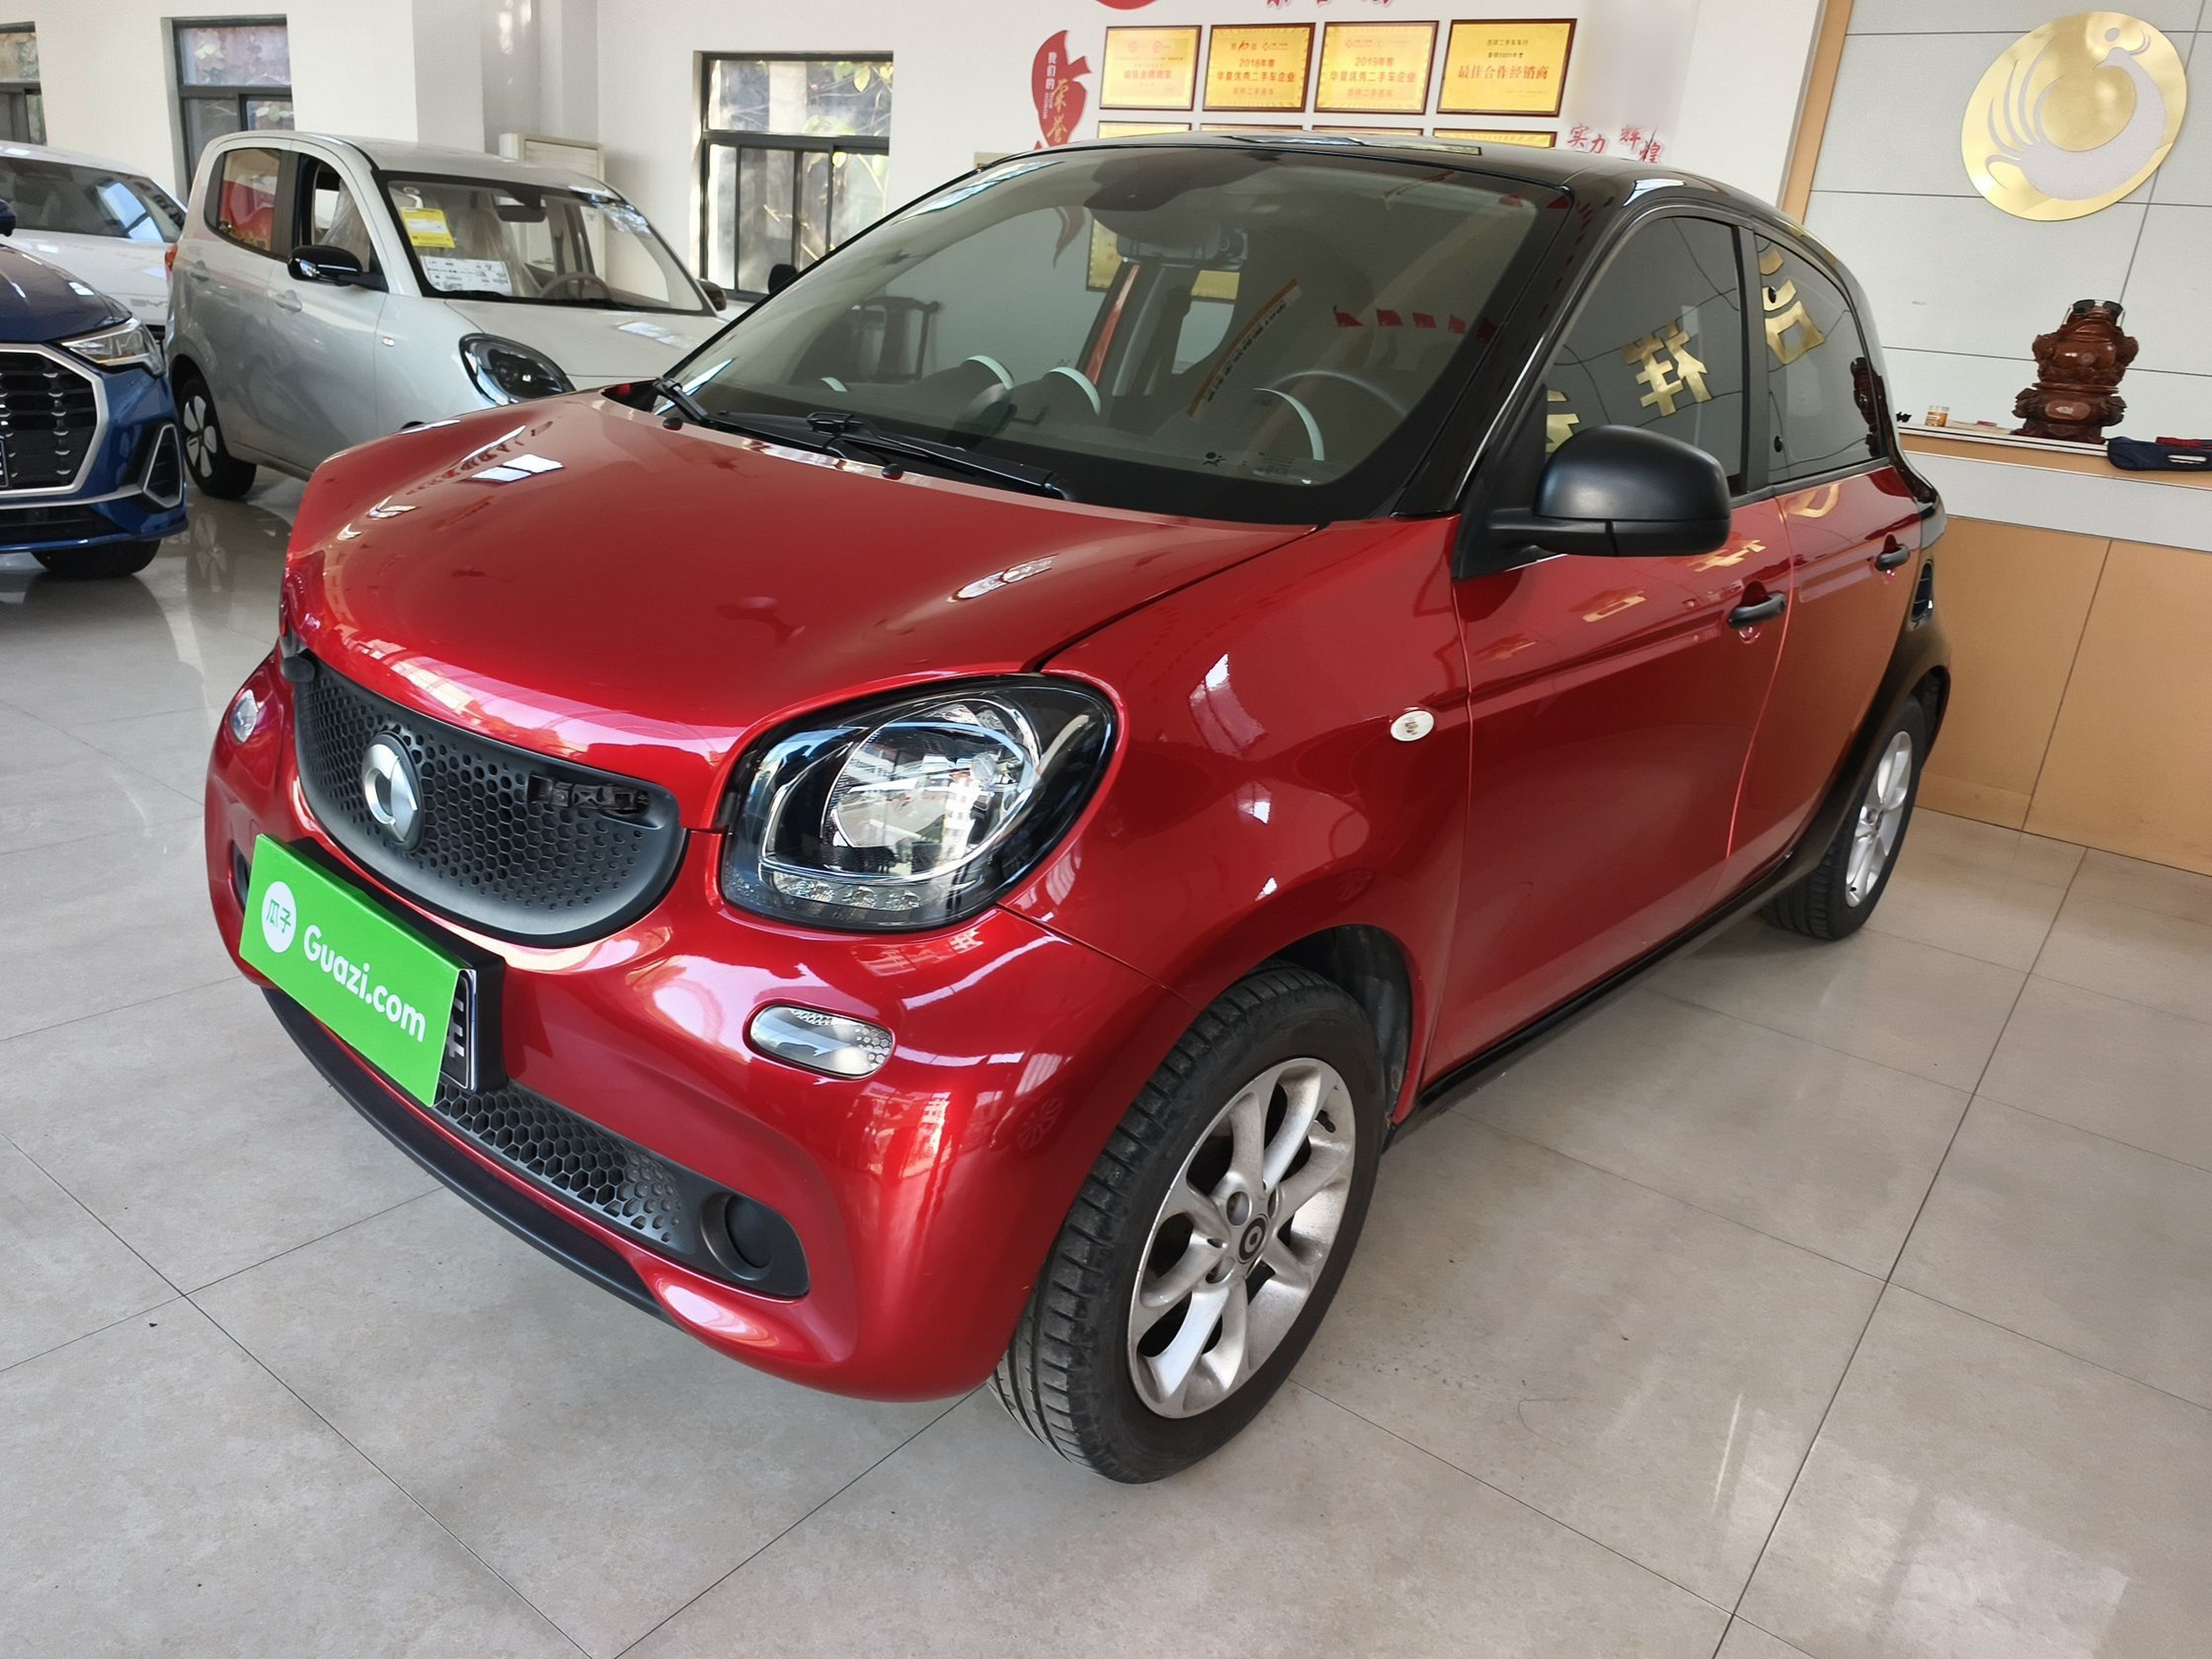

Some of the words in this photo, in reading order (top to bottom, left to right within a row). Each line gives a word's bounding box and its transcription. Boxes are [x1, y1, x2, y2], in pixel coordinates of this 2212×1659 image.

[1457, 65, 1550, 79] 最佳合作经销商
[266, 898, 292, 934] 瓜子
[304, 925, 426, 1043] Guazi.com
